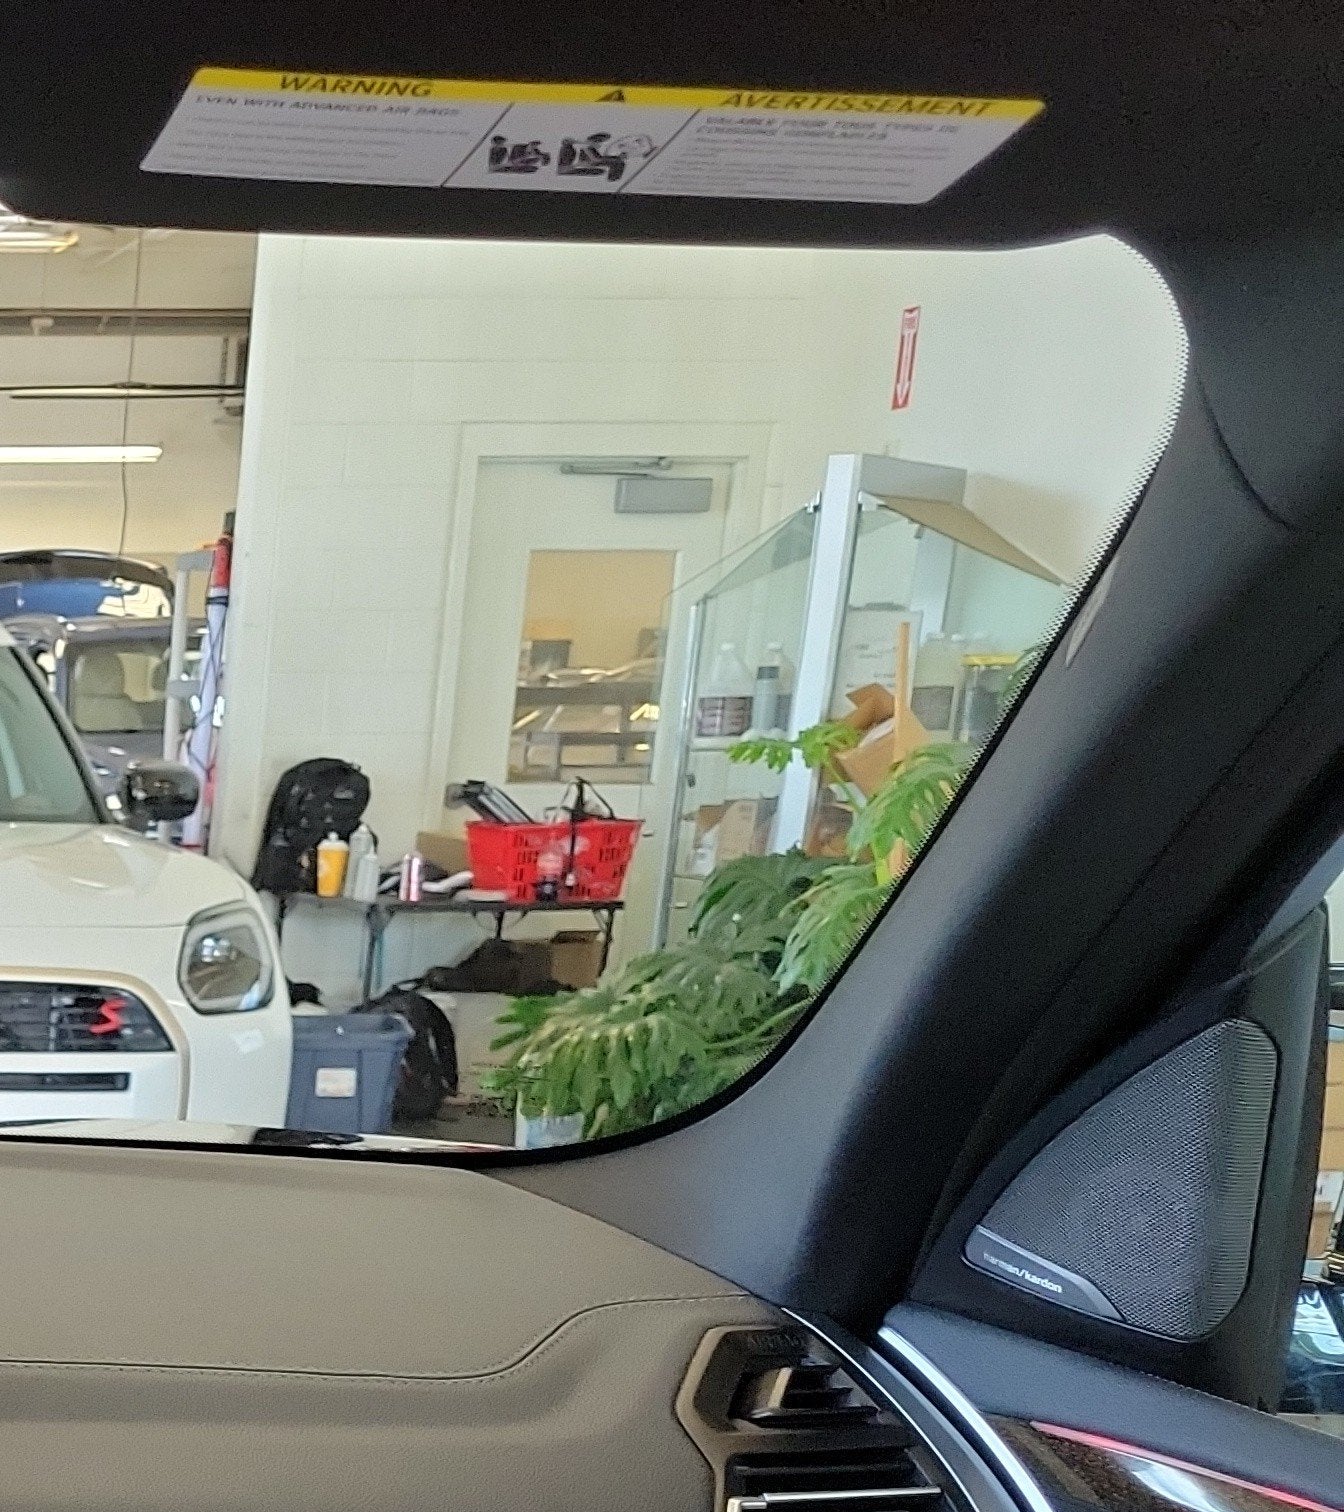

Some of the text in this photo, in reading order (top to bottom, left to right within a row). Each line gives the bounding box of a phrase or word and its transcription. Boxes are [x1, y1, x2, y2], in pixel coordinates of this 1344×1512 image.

[280, 75, 434, 97] WARNING
[721, 93, 998, 117] AVERTISSEMENT
[89, 995, 127, 1034] S
